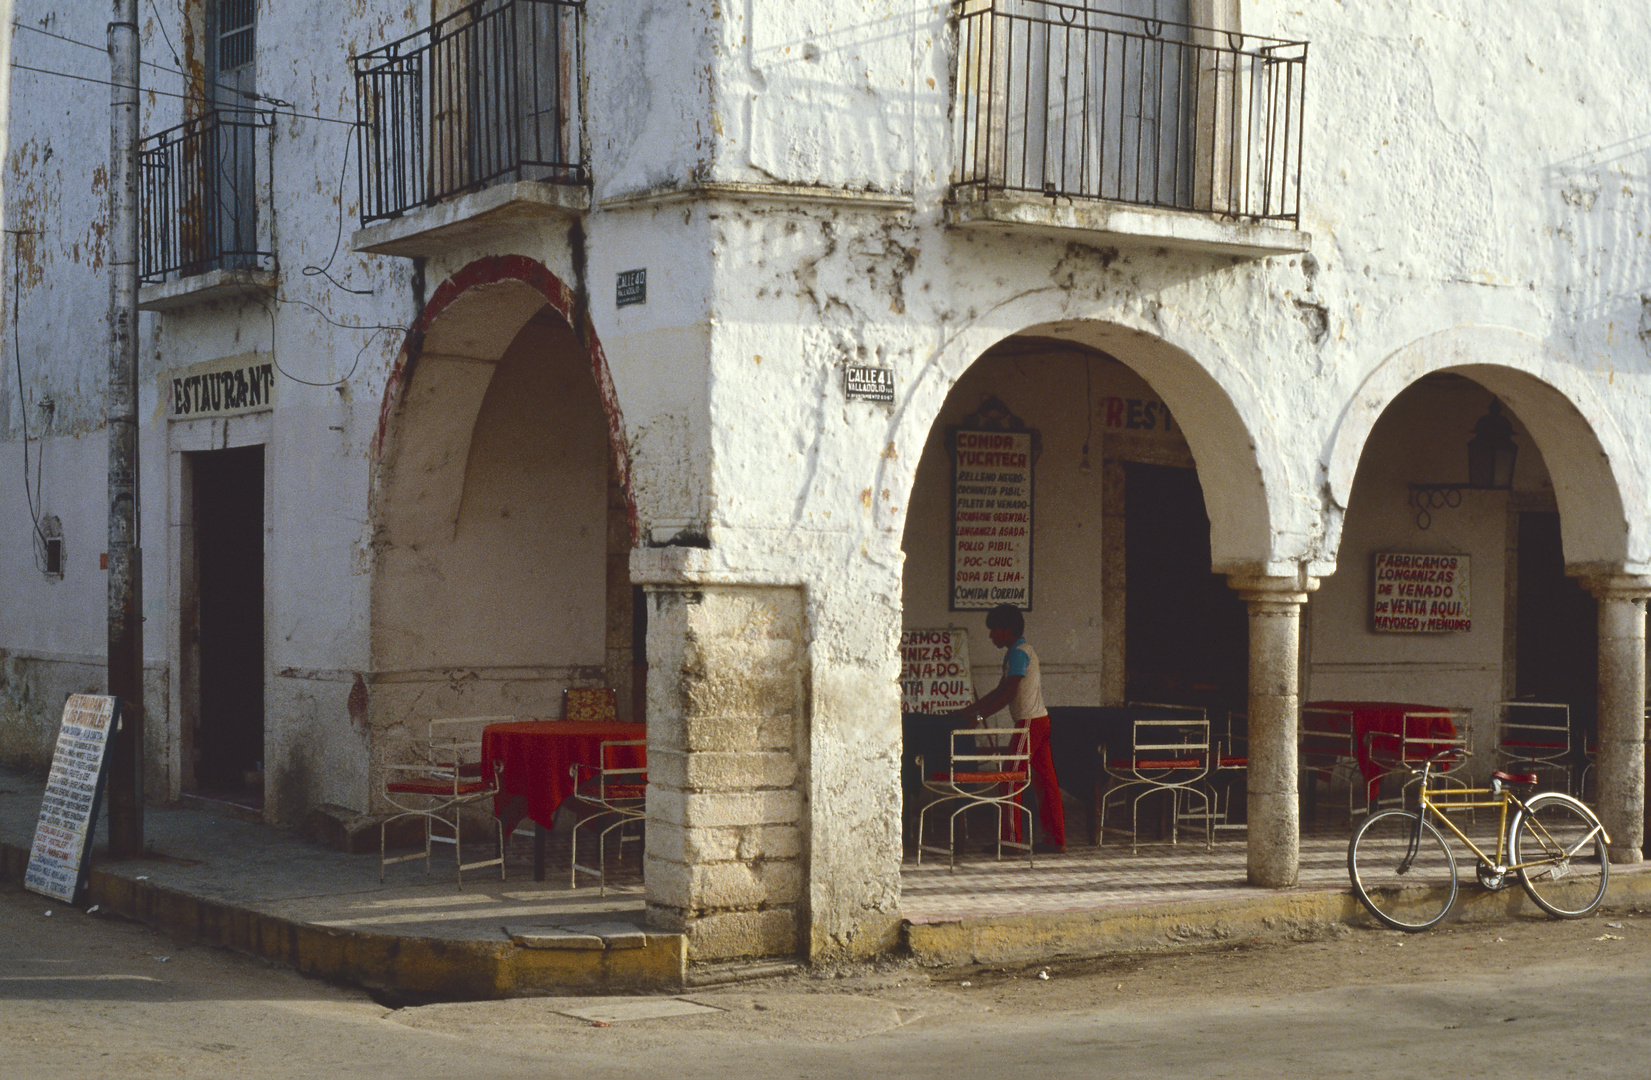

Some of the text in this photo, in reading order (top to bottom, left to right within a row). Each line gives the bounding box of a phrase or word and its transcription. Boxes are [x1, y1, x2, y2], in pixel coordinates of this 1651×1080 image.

[617, 271, 645, 289] CALLE 40
[848, 368, 892, 385] CALLE 41
[169, 363, 275, 414] ESTAURANT
[848, 383, 886, 393] VALLADOLID
[1099, 397, 1171, 431] REST
[957, 434, 1014, 450] COMIDA
[957, 450, 1027, 468] YUCATECA
[959, 471, 997, 482] RELLENO
[957, 485, 998, 496] COCHINITA
[957, 498, 985, 508] FILETE
[985, 499, 995, 509] DE
[956, 526, 997, 537] LONGANIZA
[958, 541, 1014, 552] POLLO PIBIL
[963, 556, 1013, 567] POC-CHUC
[1377, 555, 1458, 570] FABRICAMOS
[956, 571, 980, 582] SOPA
[983, 571, 995, 582] DE
[1378, 568, 1455, 583] LONGANIZAS
[954, 585, 1026, 600] COMIDA CORRIDA
[1378, 583, 1453, 598] DE VENADO
[1375, 601, 1389, 613] DE
[1390, 598, 1427, 615] VENTA
[1374, 616, 1419, 630] MAYOREO
[1427, 618, 1471, 632] MENUDEO
